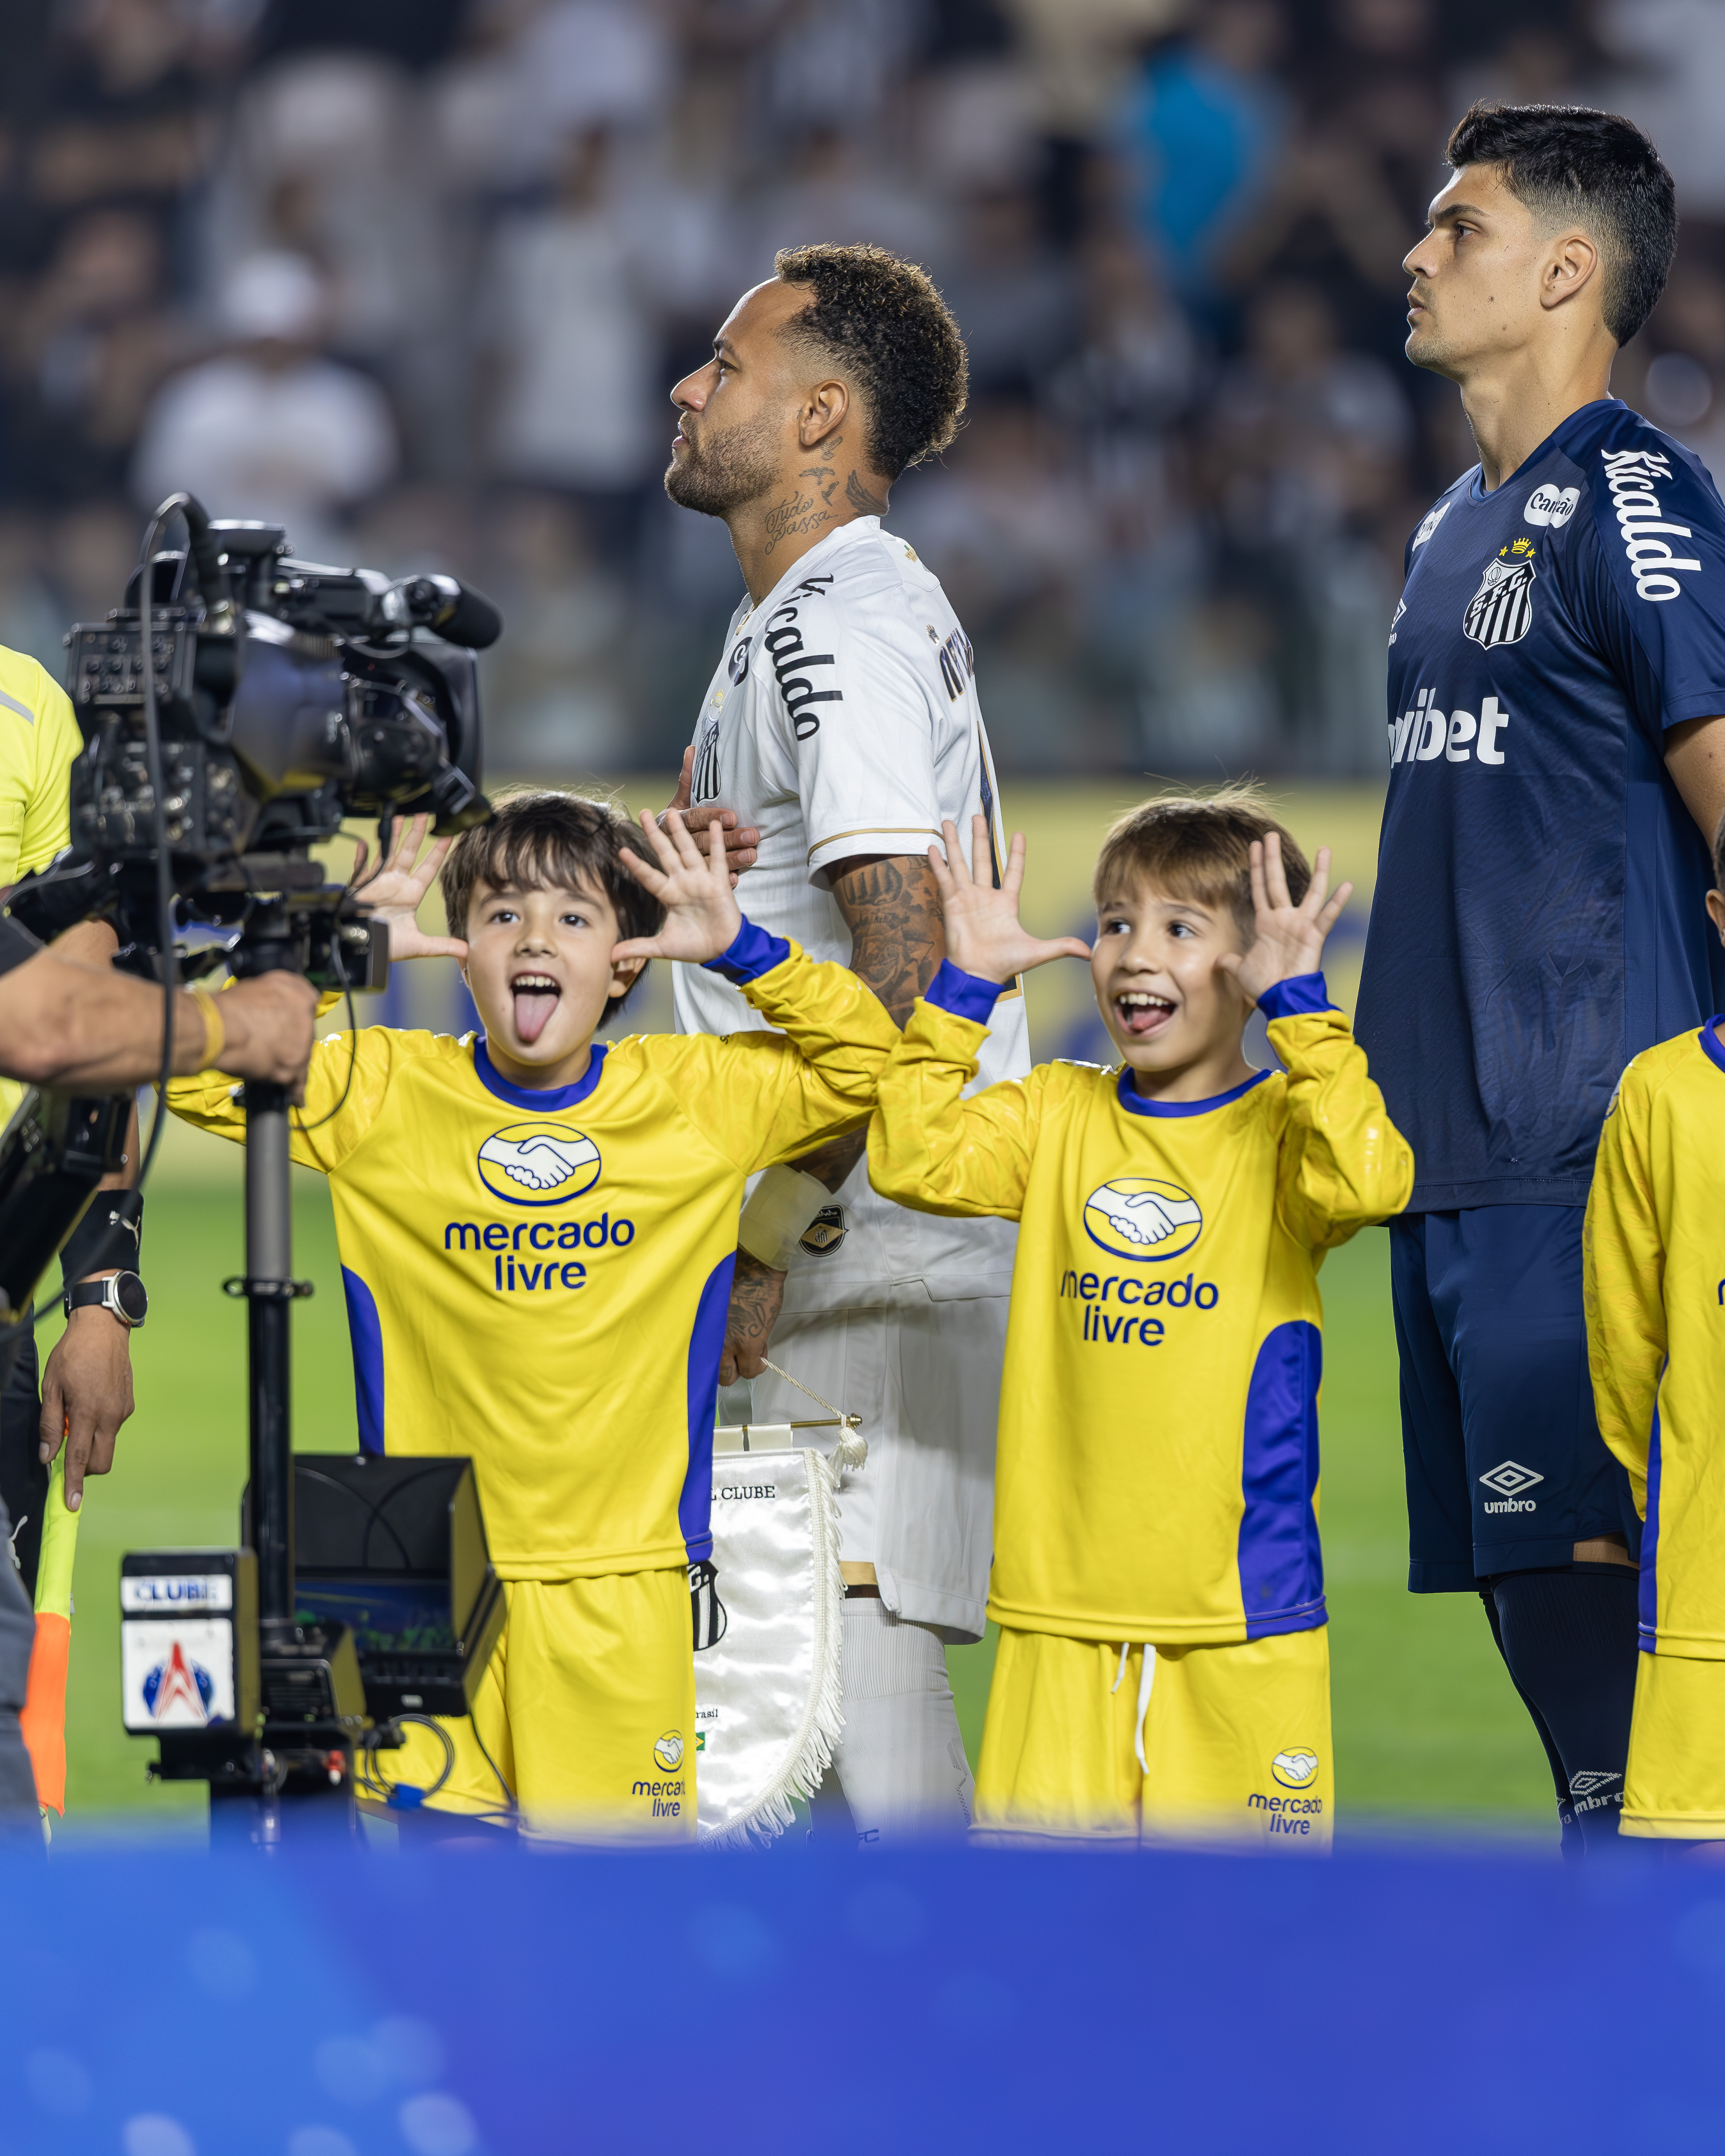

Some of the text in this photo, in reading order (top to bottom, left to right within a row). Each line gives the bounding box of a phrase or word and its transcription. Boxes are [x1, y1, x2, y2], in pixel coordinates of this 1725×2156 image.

[1530, 492, 1574, 516] Canão
[445, 1212, 635, 1251] mercado
[495, 1255, 587, 1291] livre
[1061, 1270, 1219, 1309] mercado
[1084, 1304, 1165, 1346] livre
[721, 1486, 775, 1500] CLUBE
[1484, 1498, 1536, 1514] umbro
[695, 1709, 718, 1719] rasil
[632, 1777, 685, 1797] merca
[651, 1798, 681, 1817] livre
[1270, 1813, 1310, 1835] livre
